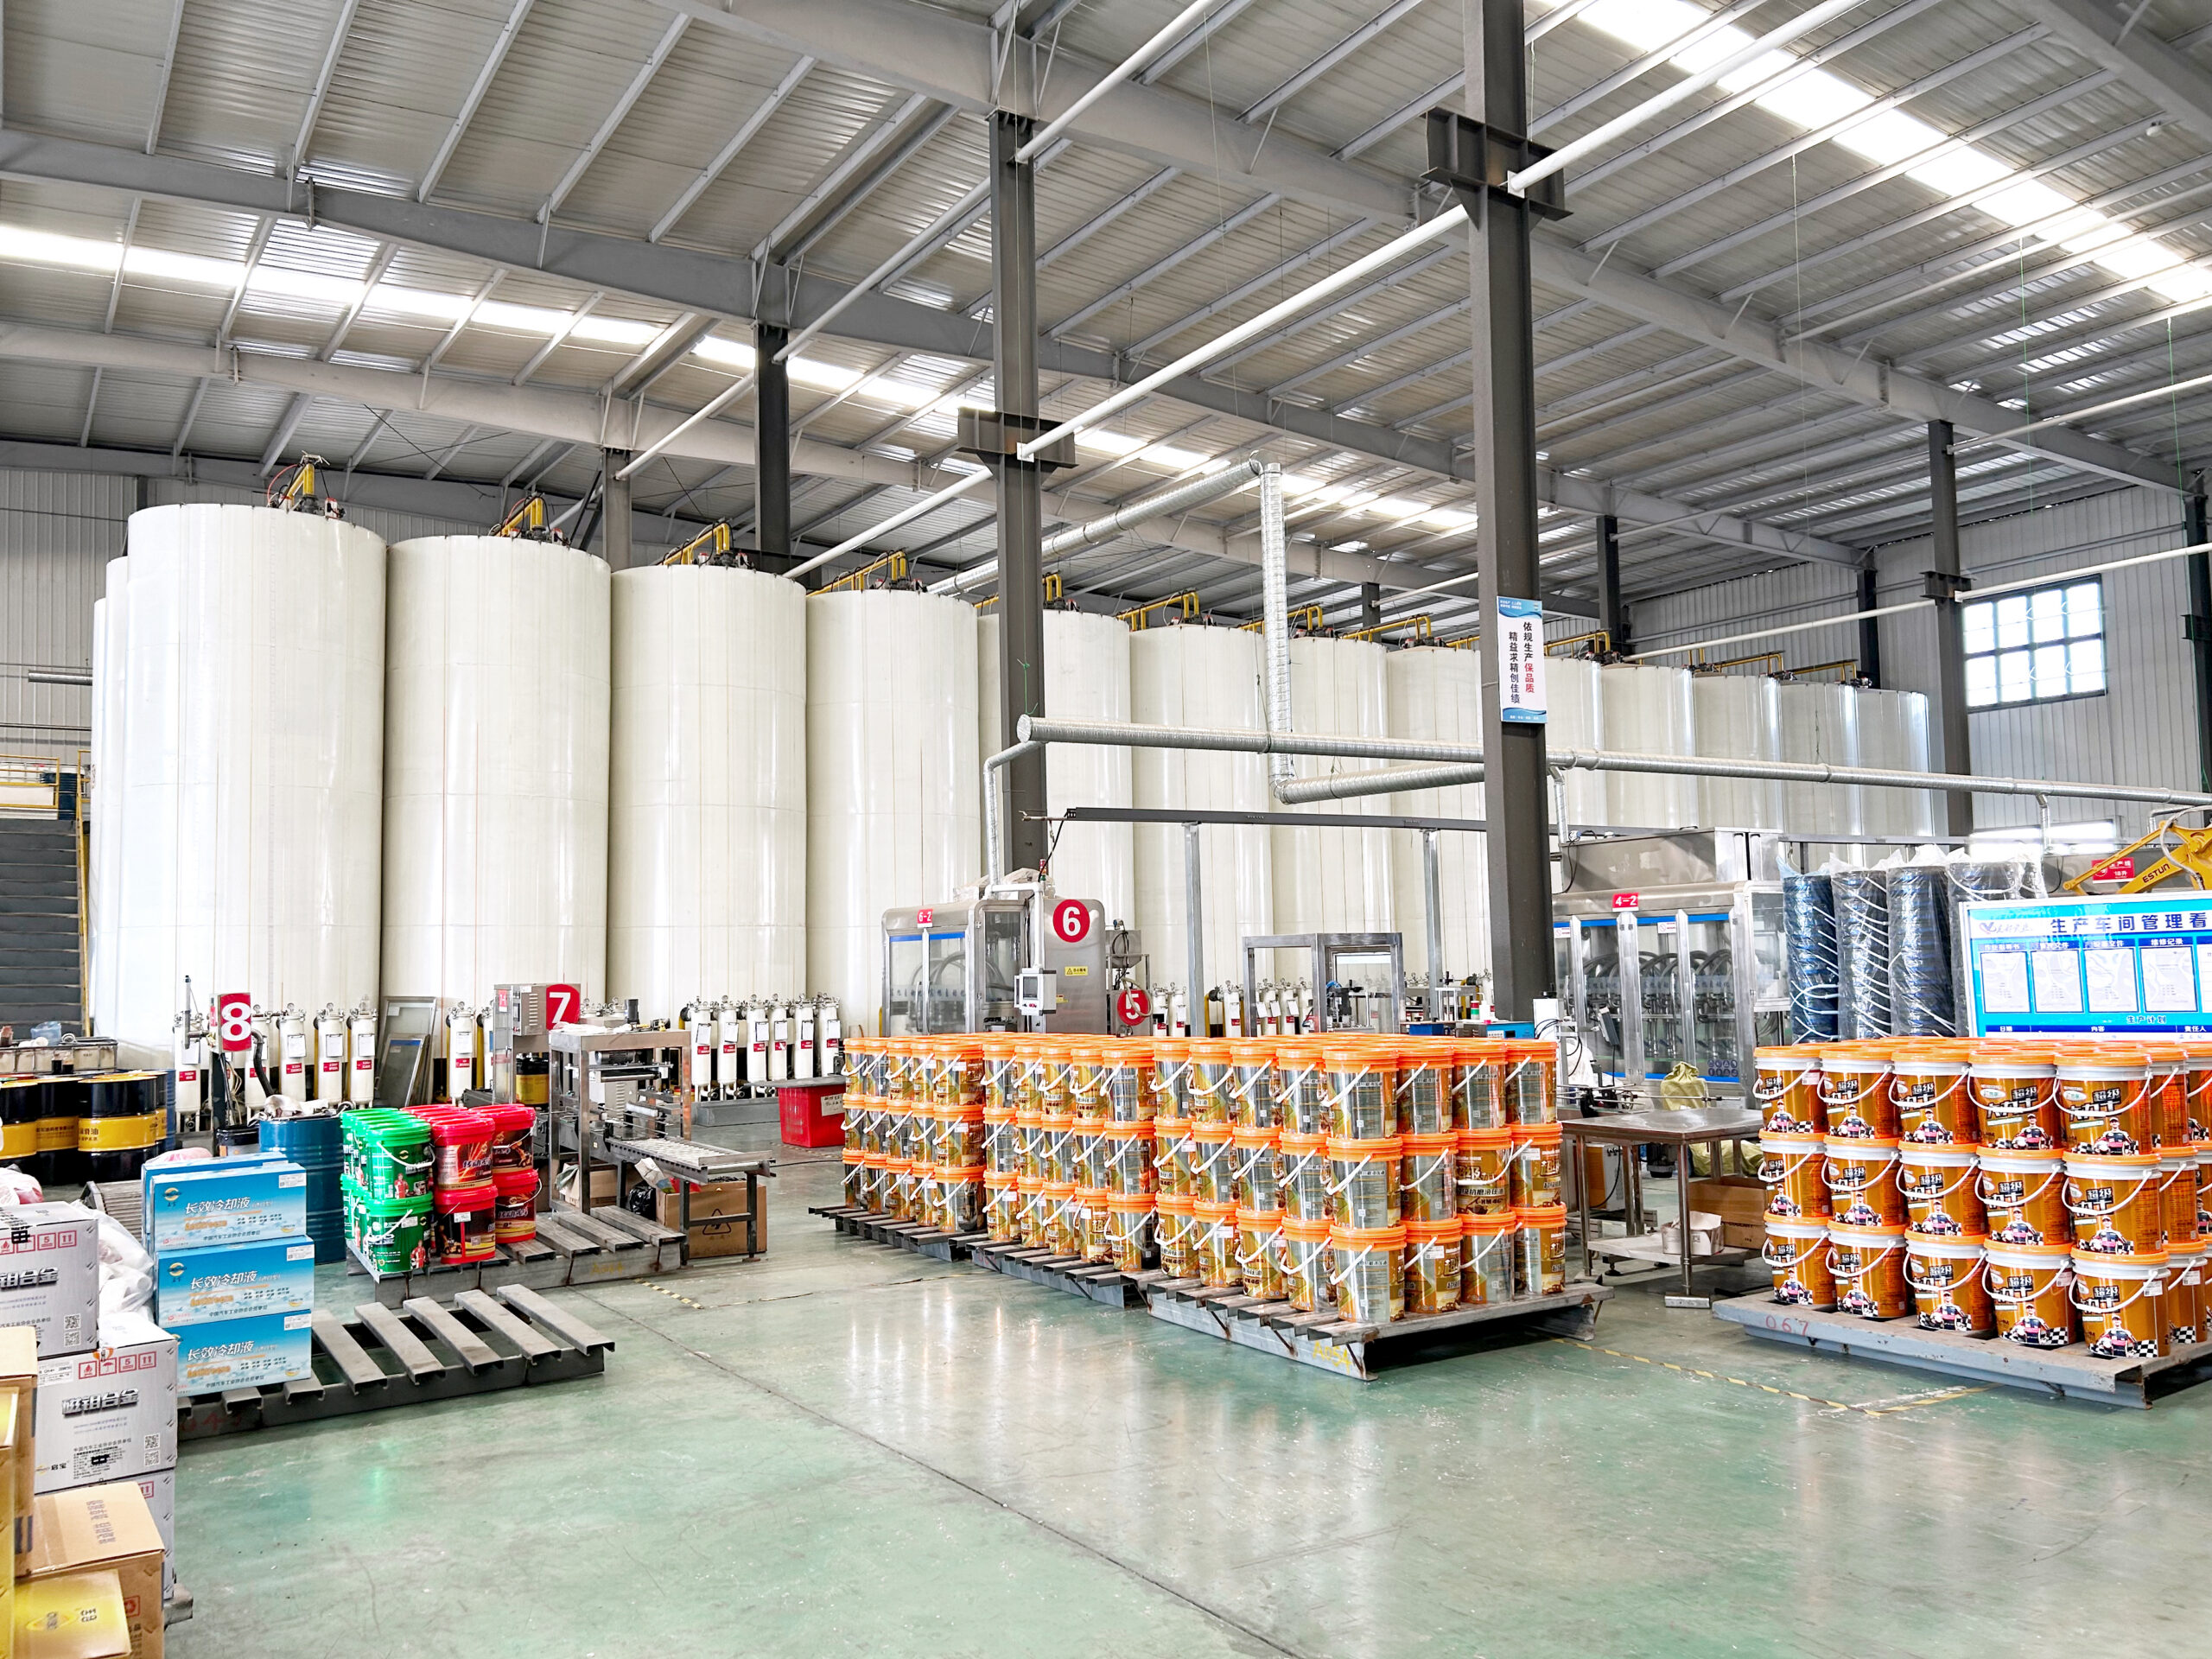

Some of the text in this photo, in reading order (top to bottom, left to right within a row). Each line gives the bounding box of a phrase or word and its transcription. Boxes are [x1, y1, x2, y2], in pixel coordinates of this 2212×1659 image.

[1523, 621, 1535, 693] 依规生产保品质
[1509, 632, 1520, 704] 精益求精创佳绩
[2142, 863, 2171, 883] ESTUN
[1615, 895, 1637, 906] 4-2
[918, 911, 931, 922] 6-2
[1062, 906, 1081, 936] 6
[2050, 912, 2208, 933] 生产车间管理看
[549, 992, 571, 1024] 7
[1125, 993, 1141, 1020] 5
[221, 1001, 252, 1041] 8
[2126, 1015, 2167, 1024] 生产计划
[185, 1197, 251, 1214] 长效冷却液
[190, 1270, 257, 1289] 长效冷却液
[1765, 1314, 1808, 1337] 067
[187, 1341, 254, 1361] 长效冷却液
